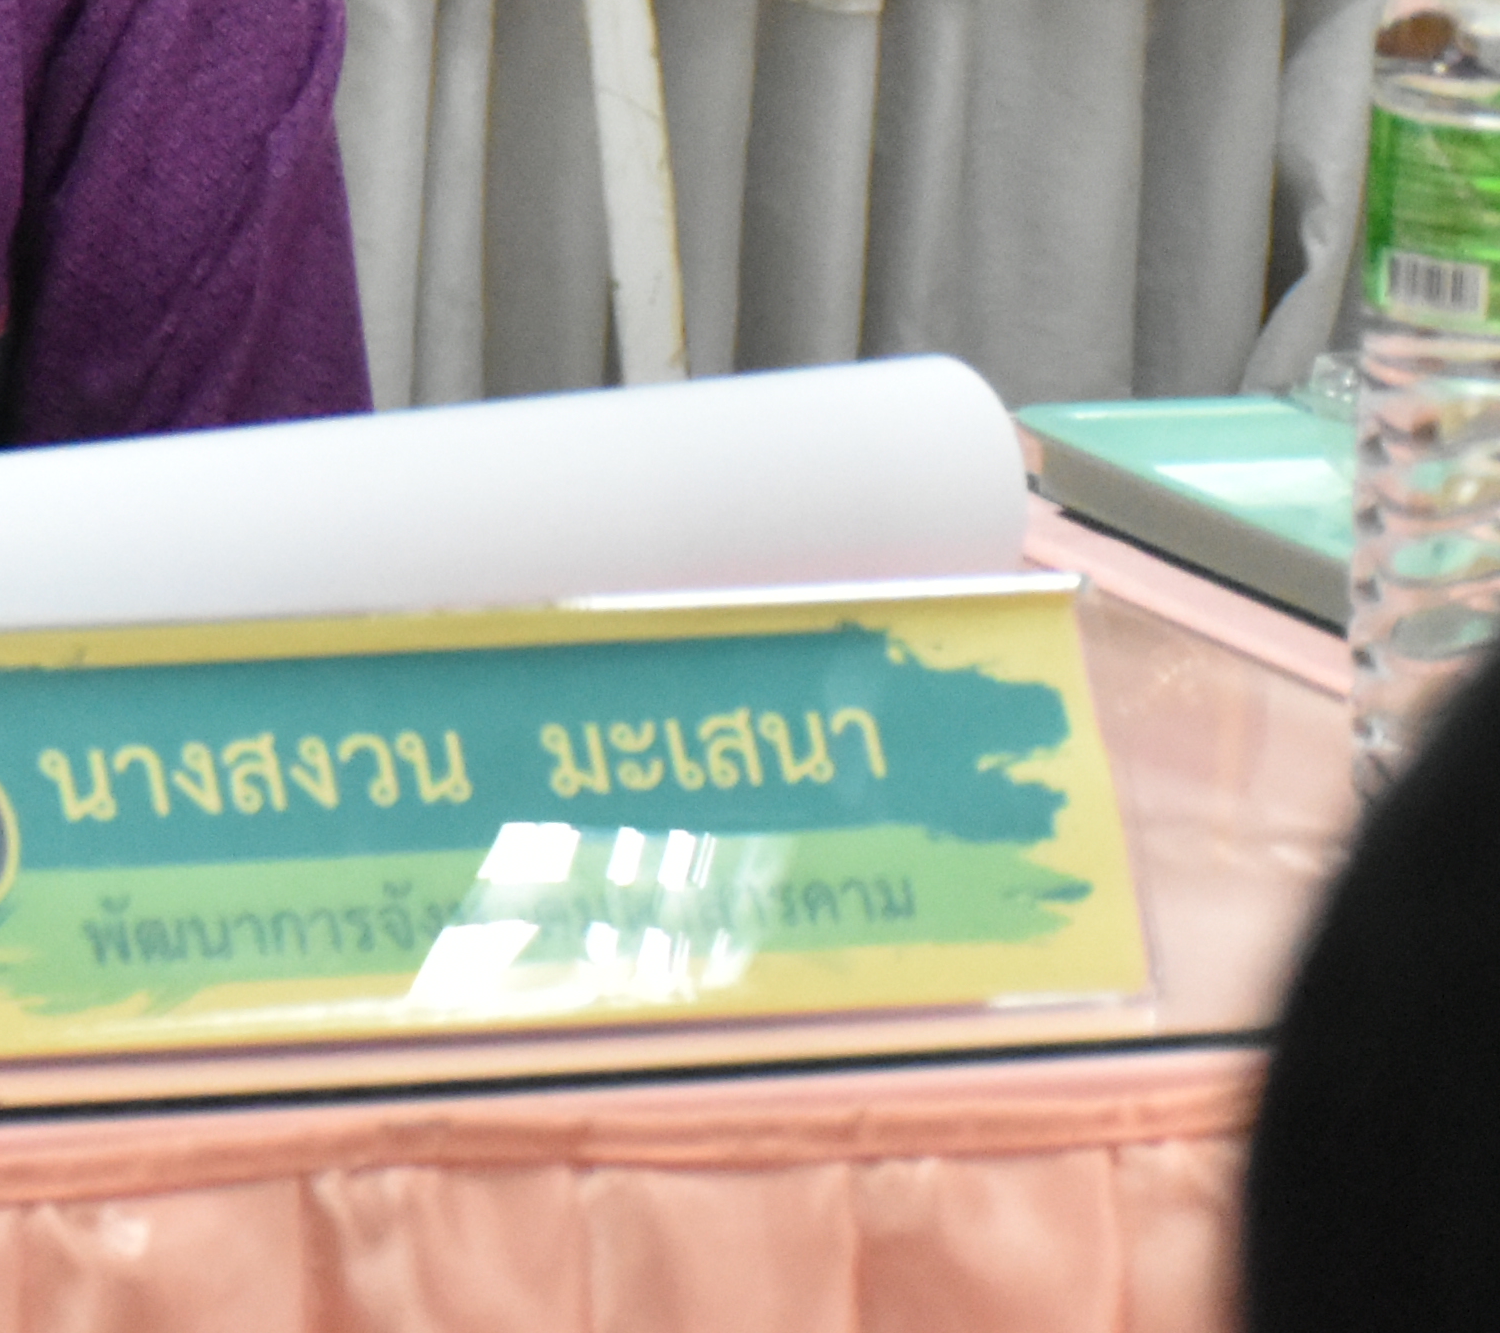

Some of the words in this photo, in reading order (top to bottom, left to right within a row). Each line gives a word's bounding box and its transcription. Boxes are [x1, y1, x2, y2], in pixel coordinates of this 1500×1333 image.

[38, 729, 472, 822] นางสงวน
[540, 706, 888, 799] มะเสนา
